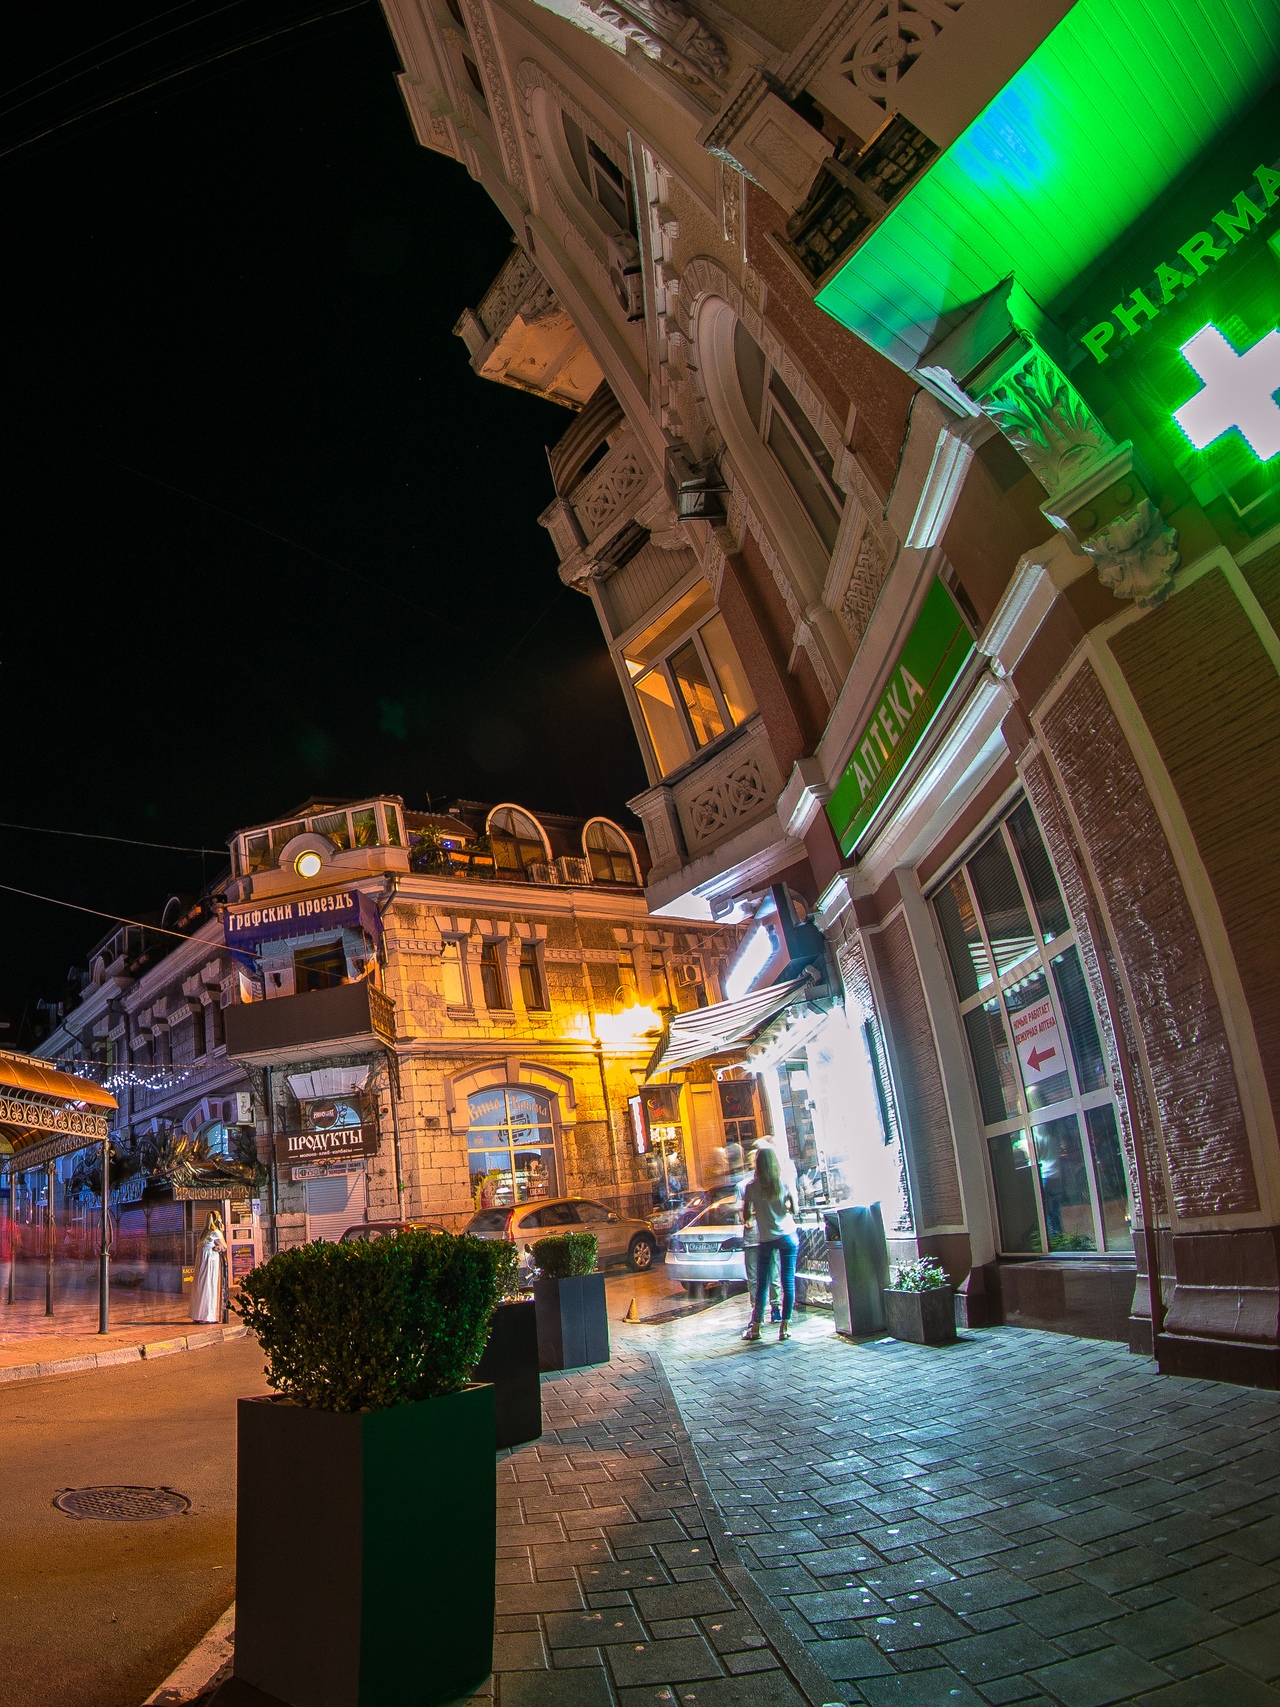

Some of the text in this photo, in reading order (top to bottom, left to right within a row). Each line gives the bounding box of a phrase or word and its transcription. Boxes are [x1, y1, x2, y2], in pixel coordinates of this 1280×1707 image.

[1081, 164, 1280, 364] PHARMA
[853, 664, 925, 802] АПТЕКА
[864, 697, 934, 816] КРУГЛОСУТОЧНО
[288, 1129, 363, 1151] ПРОДУКТЫ
